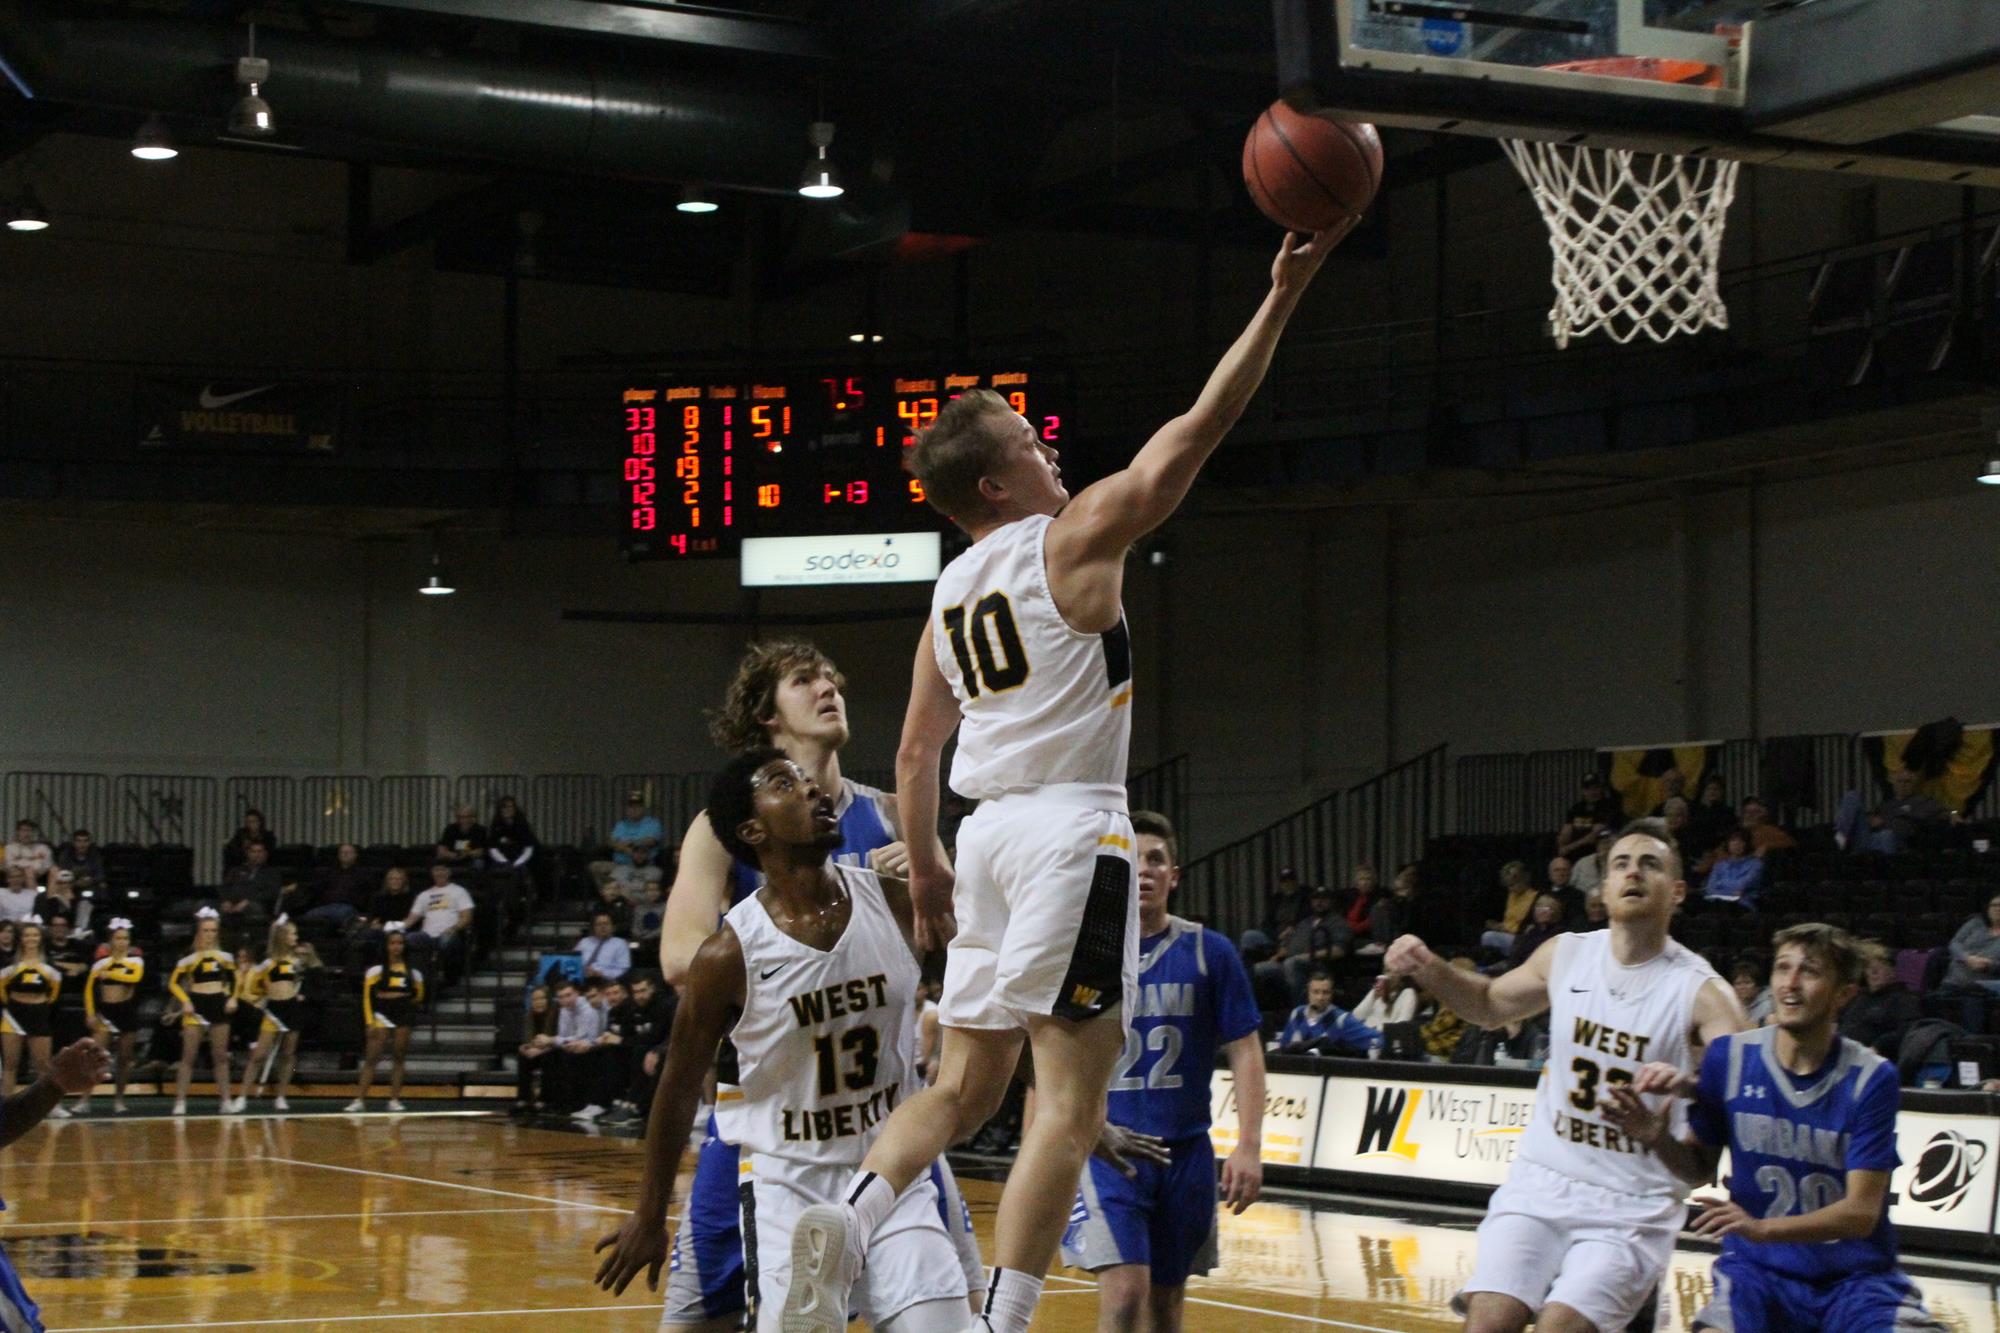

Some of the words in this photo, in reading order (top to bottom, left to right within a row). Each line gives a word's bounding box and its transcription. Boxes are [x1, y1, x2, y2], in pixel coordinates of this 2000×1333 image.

[625, 407, 656, 431] 33
[684, 405, 700, 430] 8
[751, 405, 791, 438] 51
[1043, 415, 1060, 440] 2
[632, 432, 656, 456] 10
[684, 430, 700, 455] 2
[624, 457, 656, 481] 05
[676, 455, 700, 479] 19
[632, 482, 656, 506] 12
[684, 480, 700, 505] 2
[758, 483, 781, 508] 10
[632, 507, 656, 530] 13
[692, 506, 700, 528] 1
[670, 534, 687, 554] 4
[805, 549, 901, 572] sodexo
[941, 588, 1031, 701] 10
[787, 973, 888, 1029] WEST
[1572, 1016, 1651, 1063] WEST
[814, 1023, 881, 1099] 13
[1107, 1024, 1184, 1092] 22
[782, 1082, 900, 1143] LIBERTY
[1427, 1088, 1483, 1124] WEST
[1488, 1093, 1536, 1127] LIBE
[1455, 1127, 1517, 1163] UNIVE
[1734, 1111, 1852, 1170] URBAN
[1755, 1166, 1847, 1226] 20
